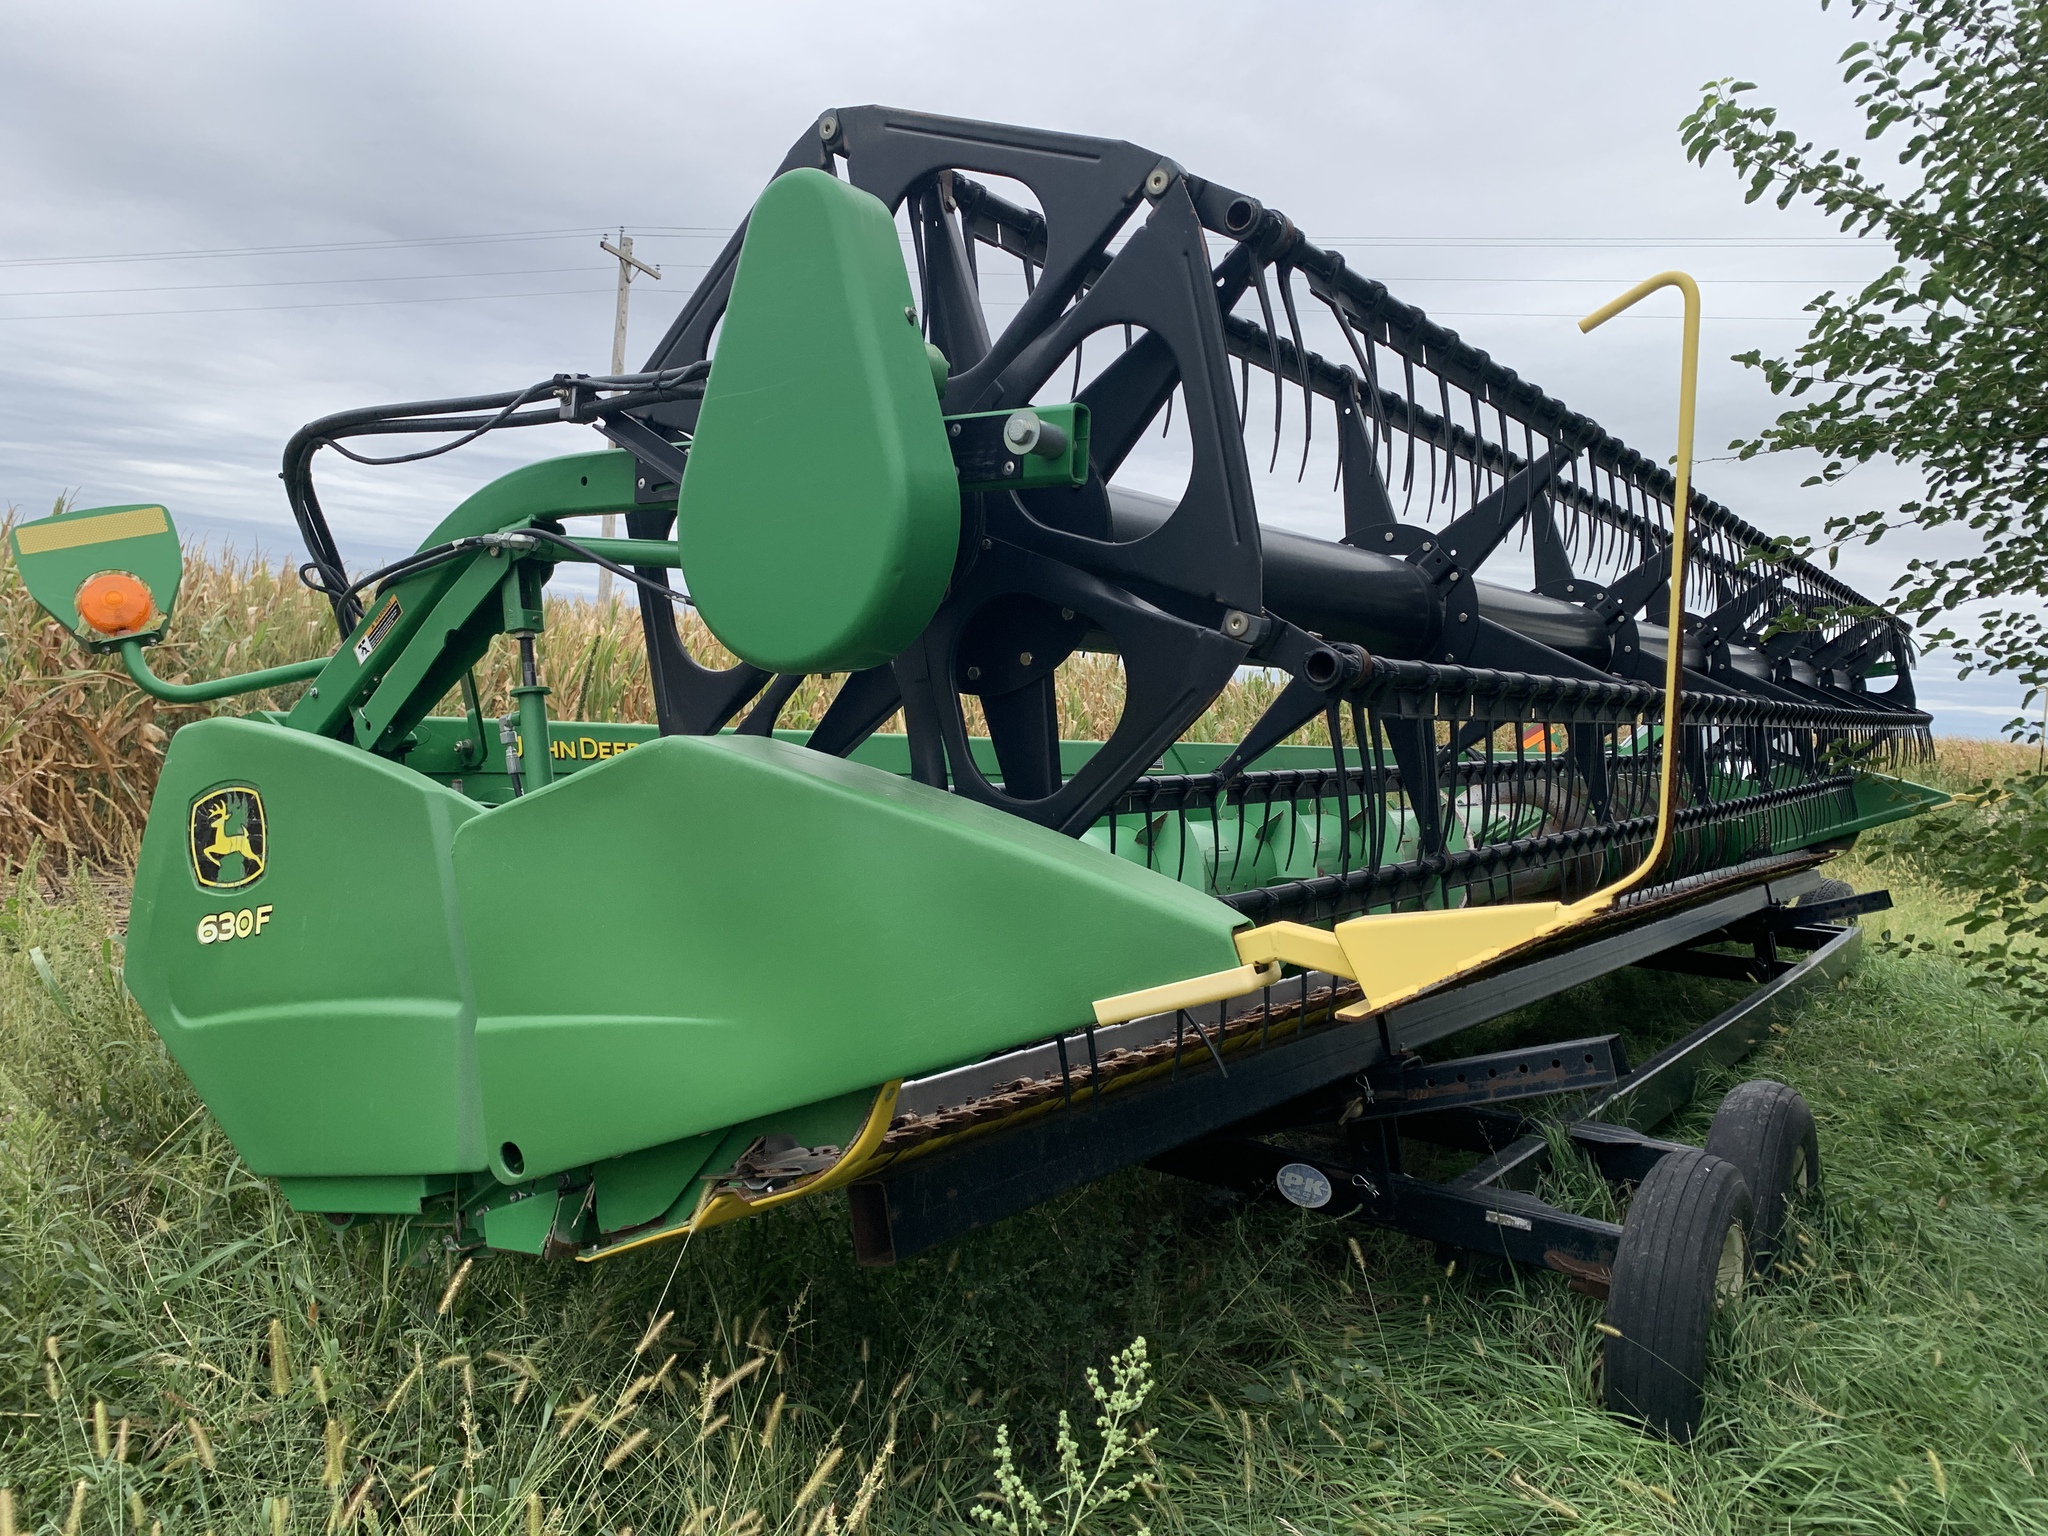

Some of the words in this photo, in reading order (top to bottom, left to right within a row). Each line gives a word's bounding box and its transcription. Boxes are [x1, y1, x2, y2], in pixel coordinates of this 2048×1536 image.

[516, 735, 577, 759] JHN
[579, 737, 641, 760] DEE
[196, 903, 274, 945] 630F
